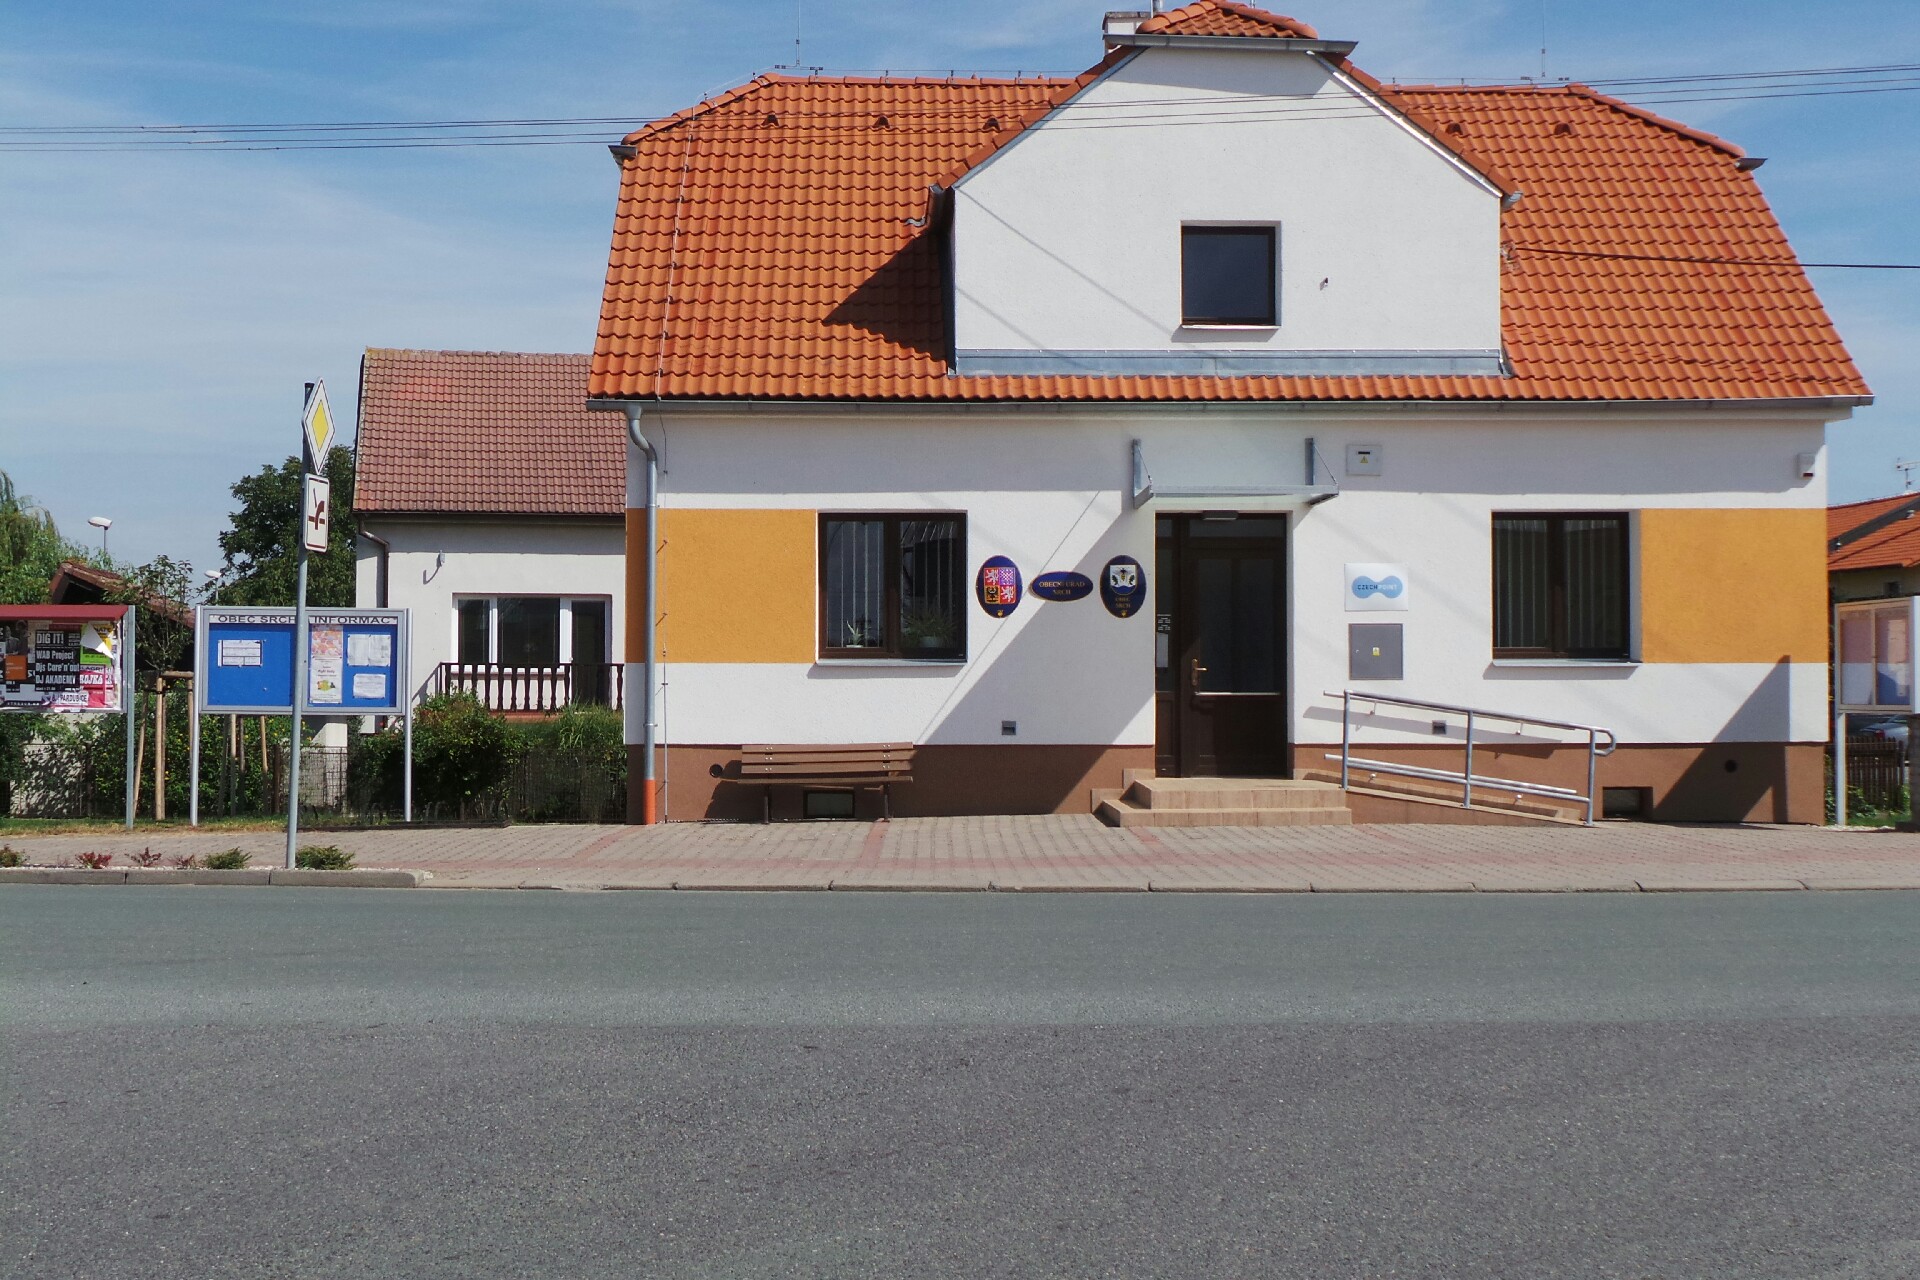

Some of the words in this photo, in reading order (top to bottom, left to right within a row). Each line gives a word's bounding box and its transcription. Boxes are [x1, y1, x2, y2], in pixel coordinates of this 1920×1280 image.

[218, 615, 255, 623] OBEC
[260, 615, 296, 624] SRCH
[36, 633, 51, 644] DIG
[53, 633, 64, 644] IT!
[36, 650, 51, 659] WAB
[51, 650, 74, 660] Project
[35, 662, 46, 672] Djs
[35, 675, 44, 684] DJ
